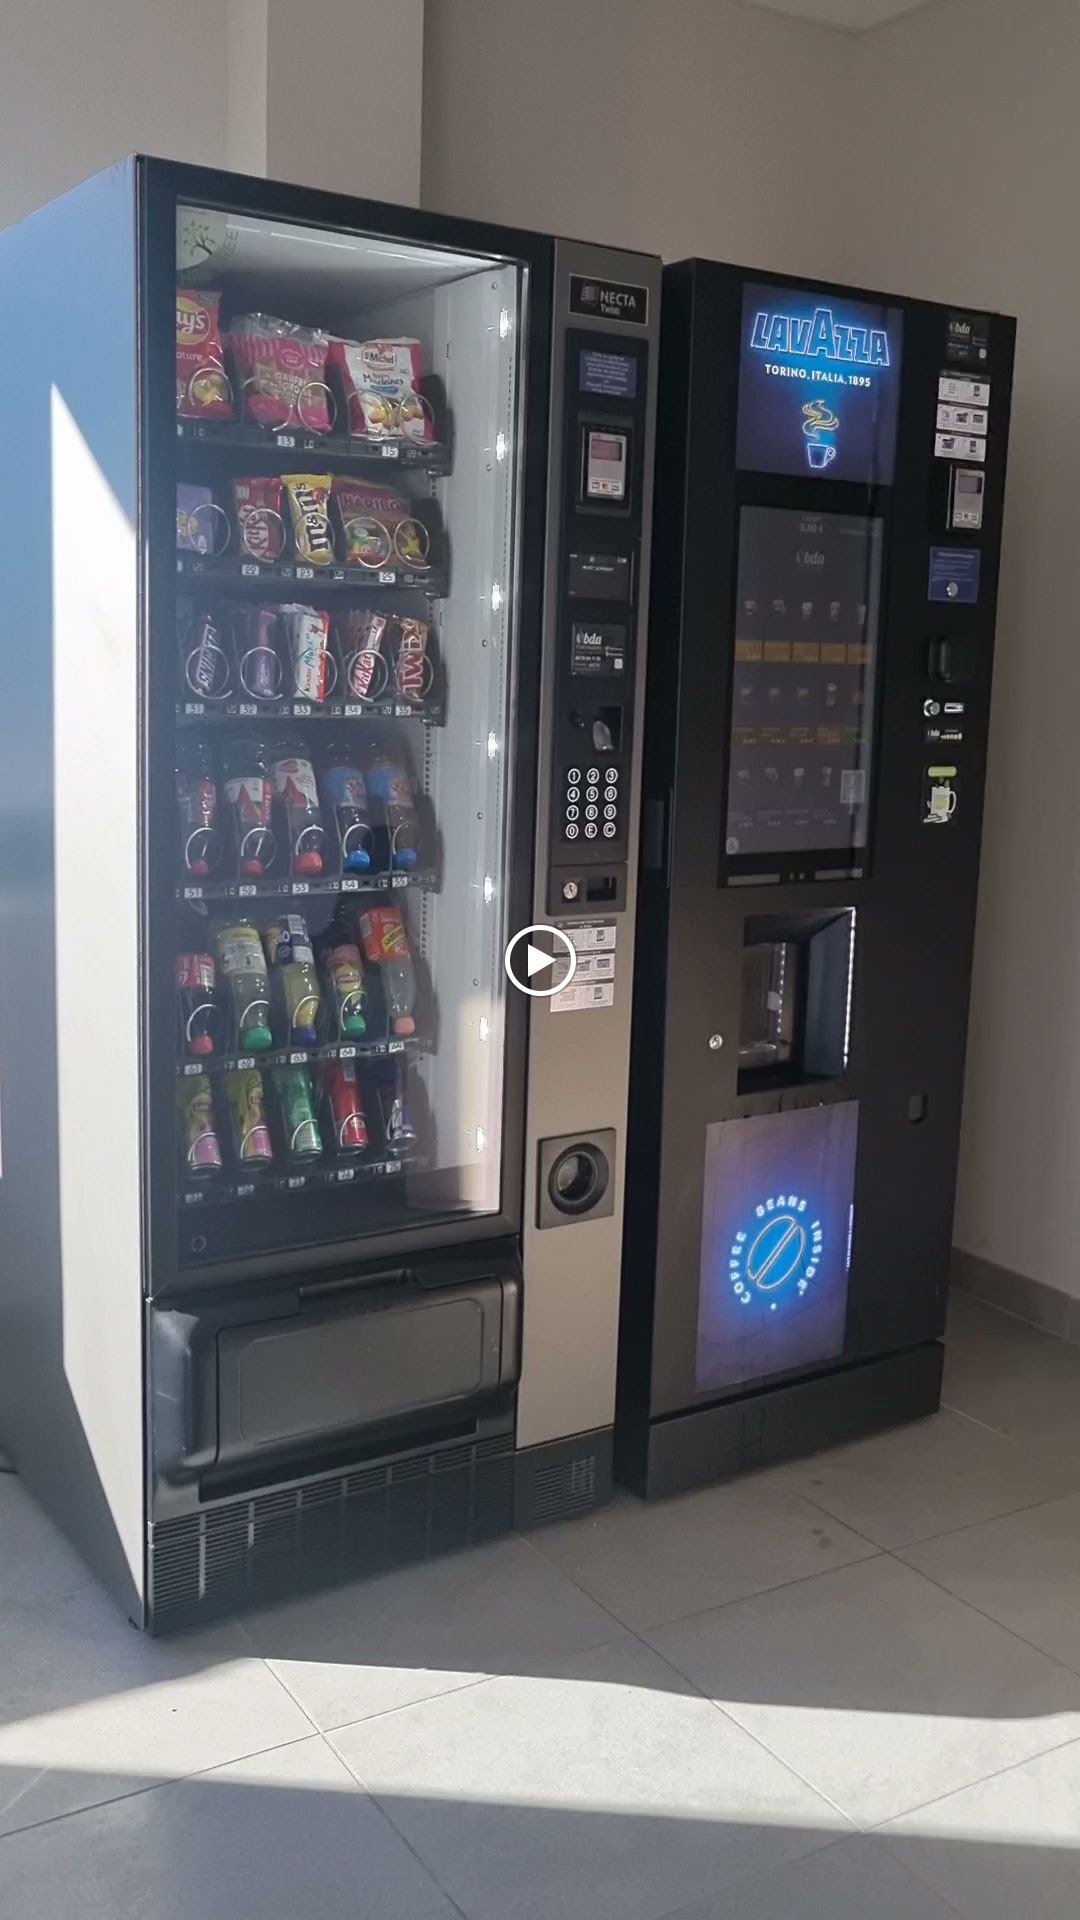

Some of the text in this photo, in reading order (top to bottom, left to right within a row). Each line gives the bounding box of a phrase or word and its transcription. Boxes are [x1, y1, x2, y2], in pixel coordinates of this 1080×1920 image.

[600, 290, 636, 308] NECTA
[751, 308, 890, 366] LAVAZZA
[848, 375, 871, 387] 1895
[583, 632, 602, 645] bda
[729, 1231, 752, 1304] COFFEE
[755, 1195, 807, 1217] BEANS
